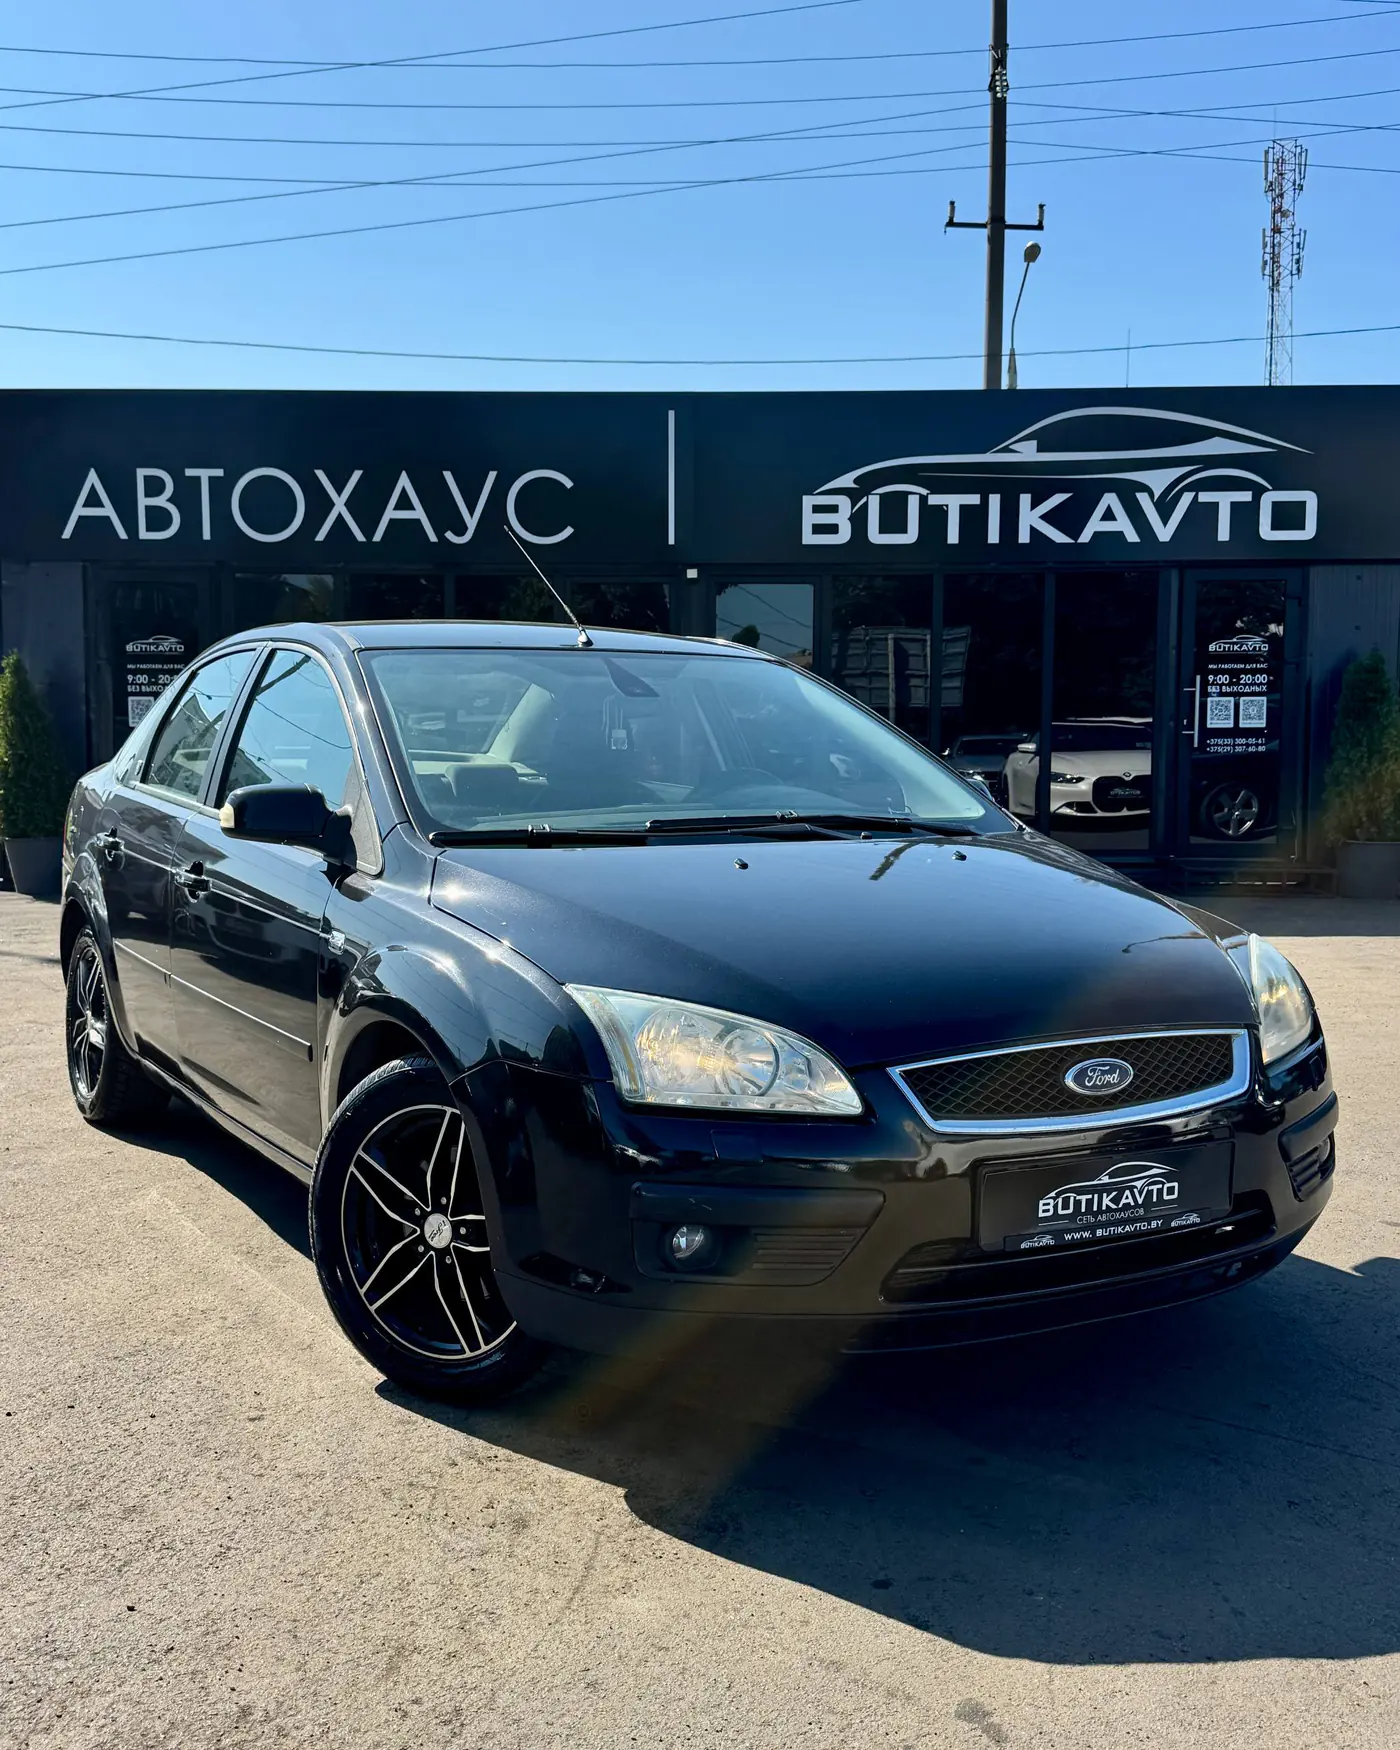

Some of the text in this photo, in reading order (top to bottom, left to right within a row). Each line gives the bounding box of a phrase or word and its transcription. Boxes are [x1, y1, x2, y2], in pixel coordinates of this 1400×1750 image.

[61, 466, 575, 545] АВТОХАУС
[801, 490, 1318, 545] BUTIKAVTO
[126, 644, 185, 652] BUTIKAVTO
[1208, 643, 1269, 652] BUTIKAVTO
[127, 674, 149, 684] 9:00
[158, 674, 179, 684] 20:
[1208, 674, 1230, 684] 9:00
[1240, 674, 1268, 684] 20:00
[1085, 1066, 1120, 1087] Ford
[1038, 1182, 1179, 1218] BUTIKAVTO
[1076, 1207, 1145, 1224] СЕТЬ АВТОХАУСОВ
[1171, 1217, 1200, 1227] BUTIKAVTO
[1064, 1219, 1163, 1241] WWW. BUTIKAVTO.BY
[1020, 1239, 1055, 1249] BUTIKAVTO
